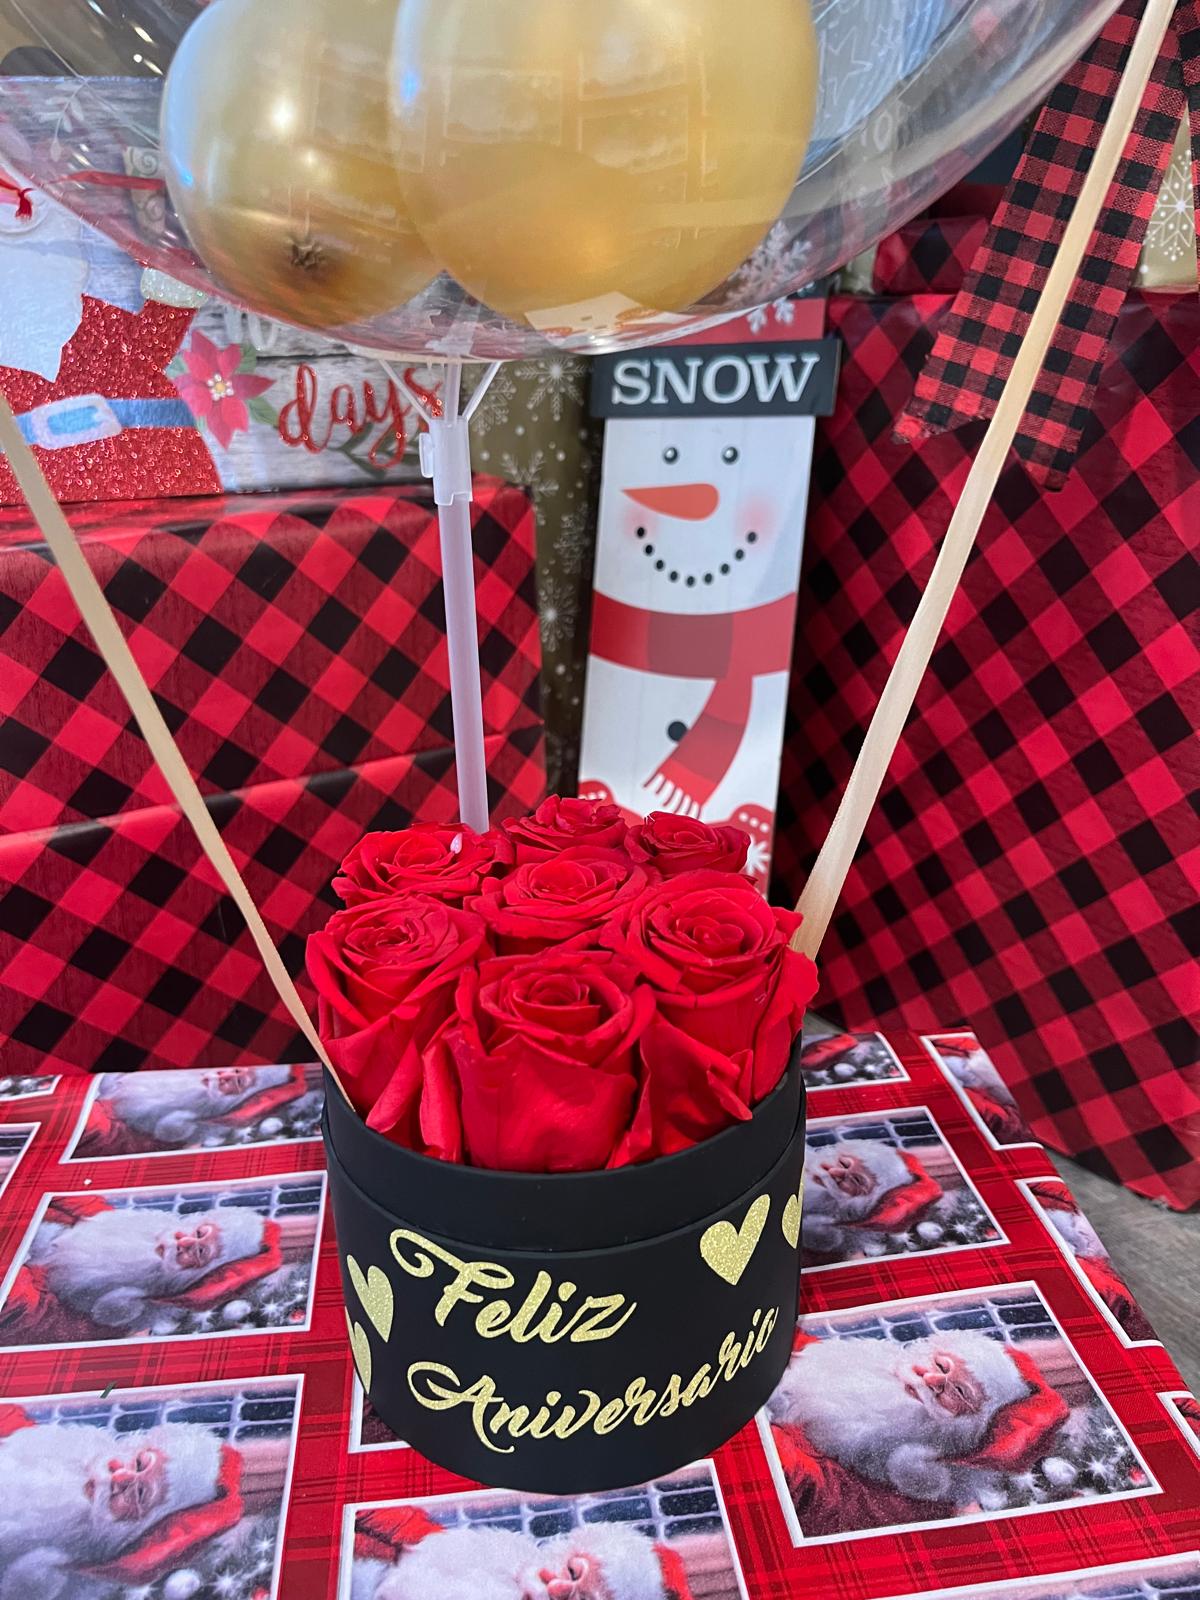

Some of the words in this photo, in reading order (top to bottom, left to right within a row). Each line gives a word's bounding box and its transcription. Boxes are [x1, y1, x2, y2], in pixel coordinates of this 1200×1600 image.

[611, 354, 820, 405] SNOW
[389, 1228, 637, 1343] Feliz
[407, 1306, 779, 1453] Aniversario
